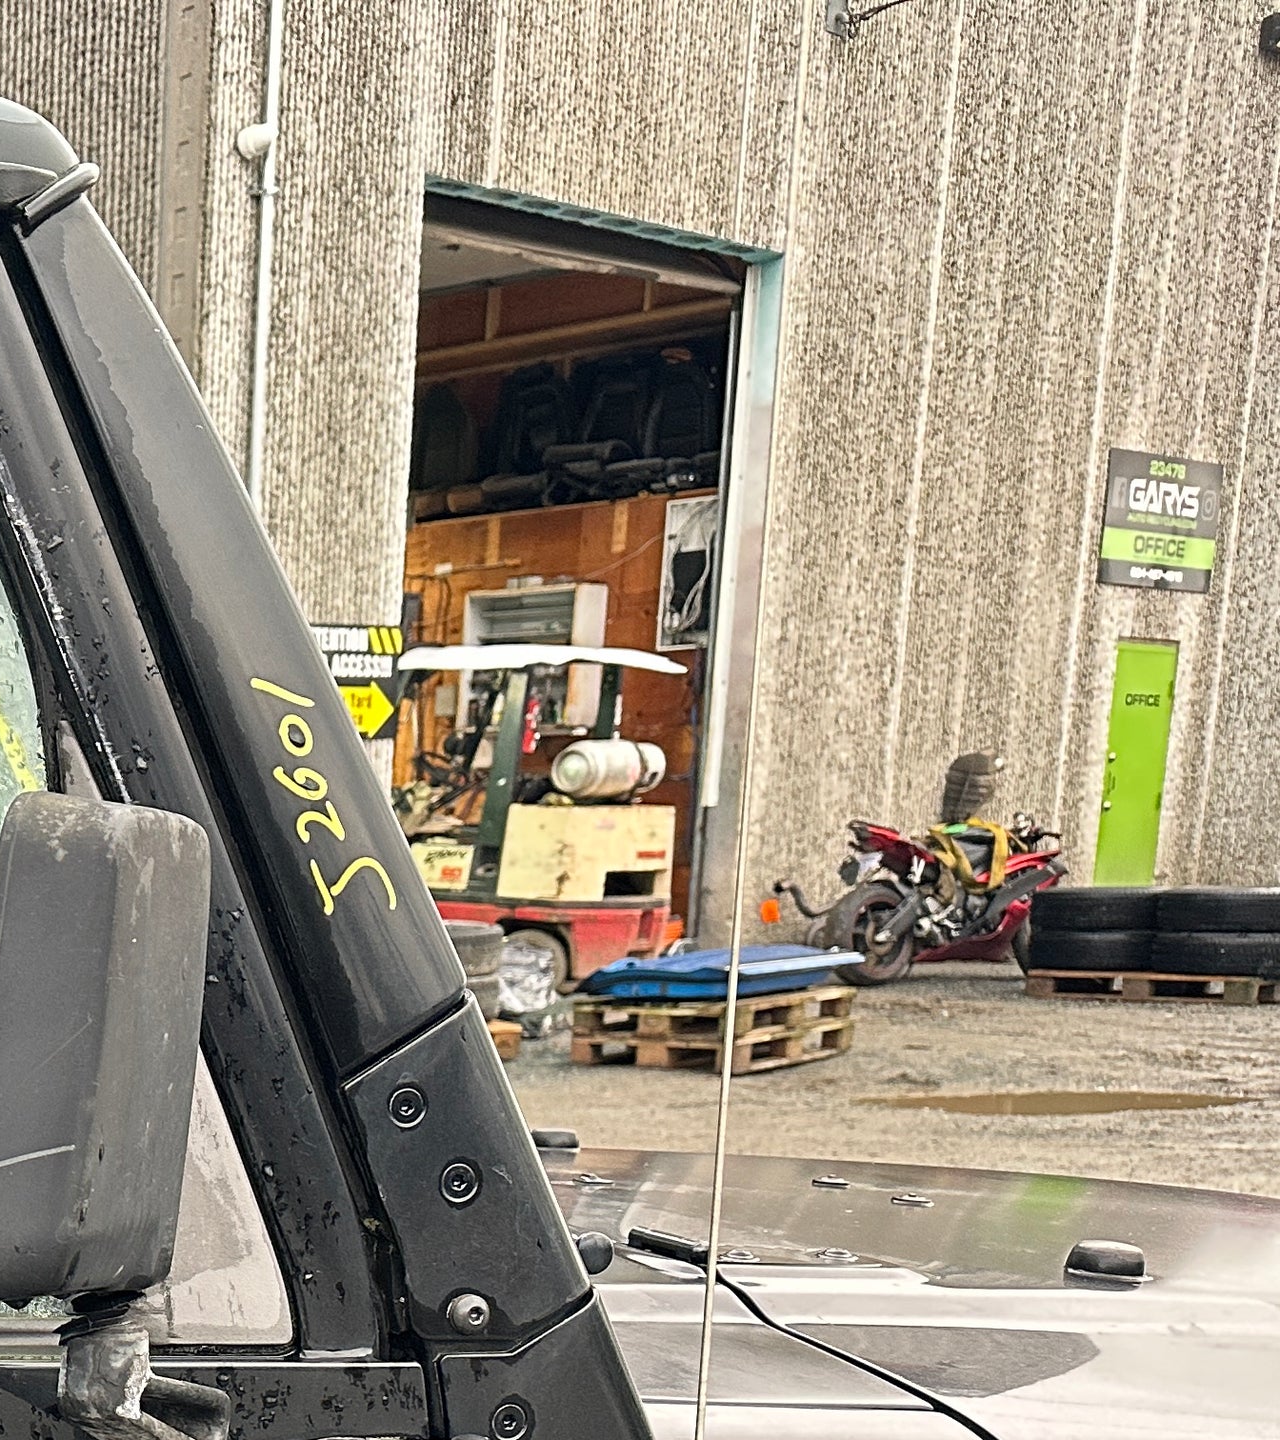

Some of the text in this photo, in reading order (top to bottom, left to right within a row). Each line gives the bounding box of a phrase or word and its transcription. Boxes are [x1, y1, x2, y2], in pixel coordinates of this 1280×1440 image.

[1128, 478, 1201, 519] GARYS
[1133, 535, 1186, 559] OFFICE
[1125, 693, 1161, 707] OFFICE
[250, 677, 397, 916] J2601
